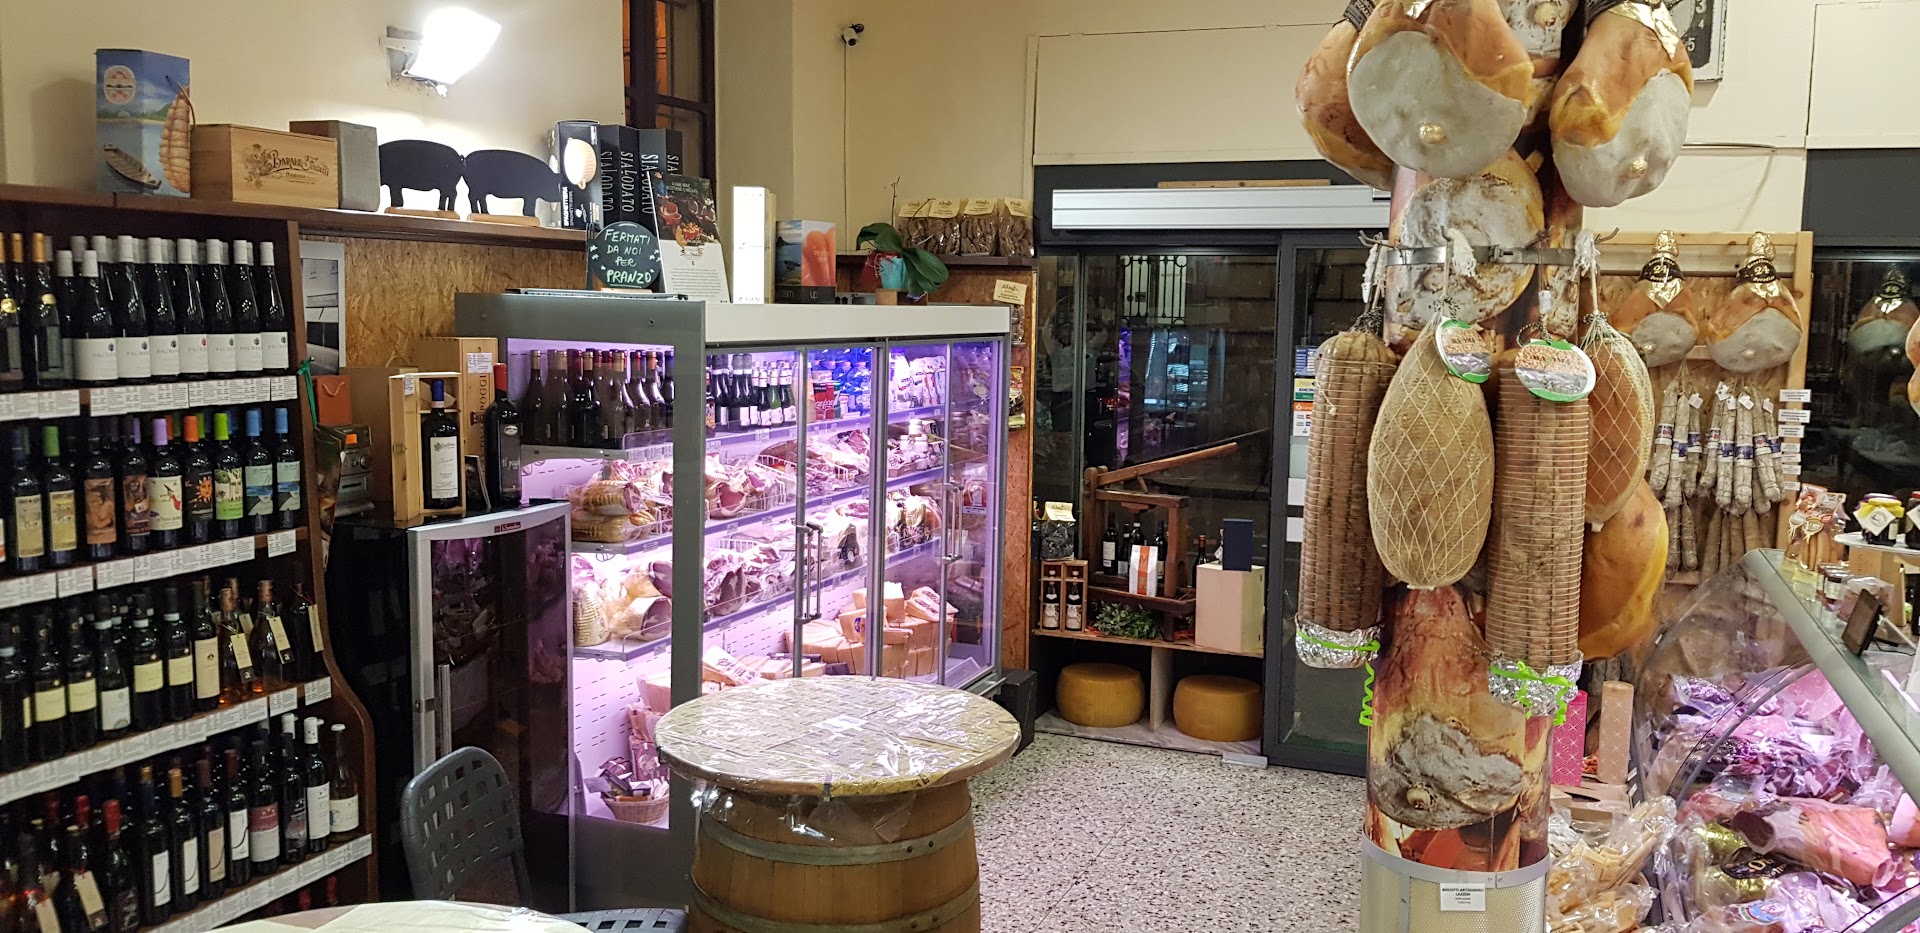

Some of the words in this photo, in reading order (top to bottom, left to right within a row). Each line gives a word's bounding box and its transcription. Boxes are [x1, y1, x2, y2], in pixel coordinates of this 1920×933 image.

[1698, 19, 1705, 29] 4
[1687, 37, 1696, 51] 5
[604, 228, 651, 245] FERMATI
[606, 244, 620, 254] DA
[624, 246, 642, 255] NOI
[615, 256, 637, 267] PER
